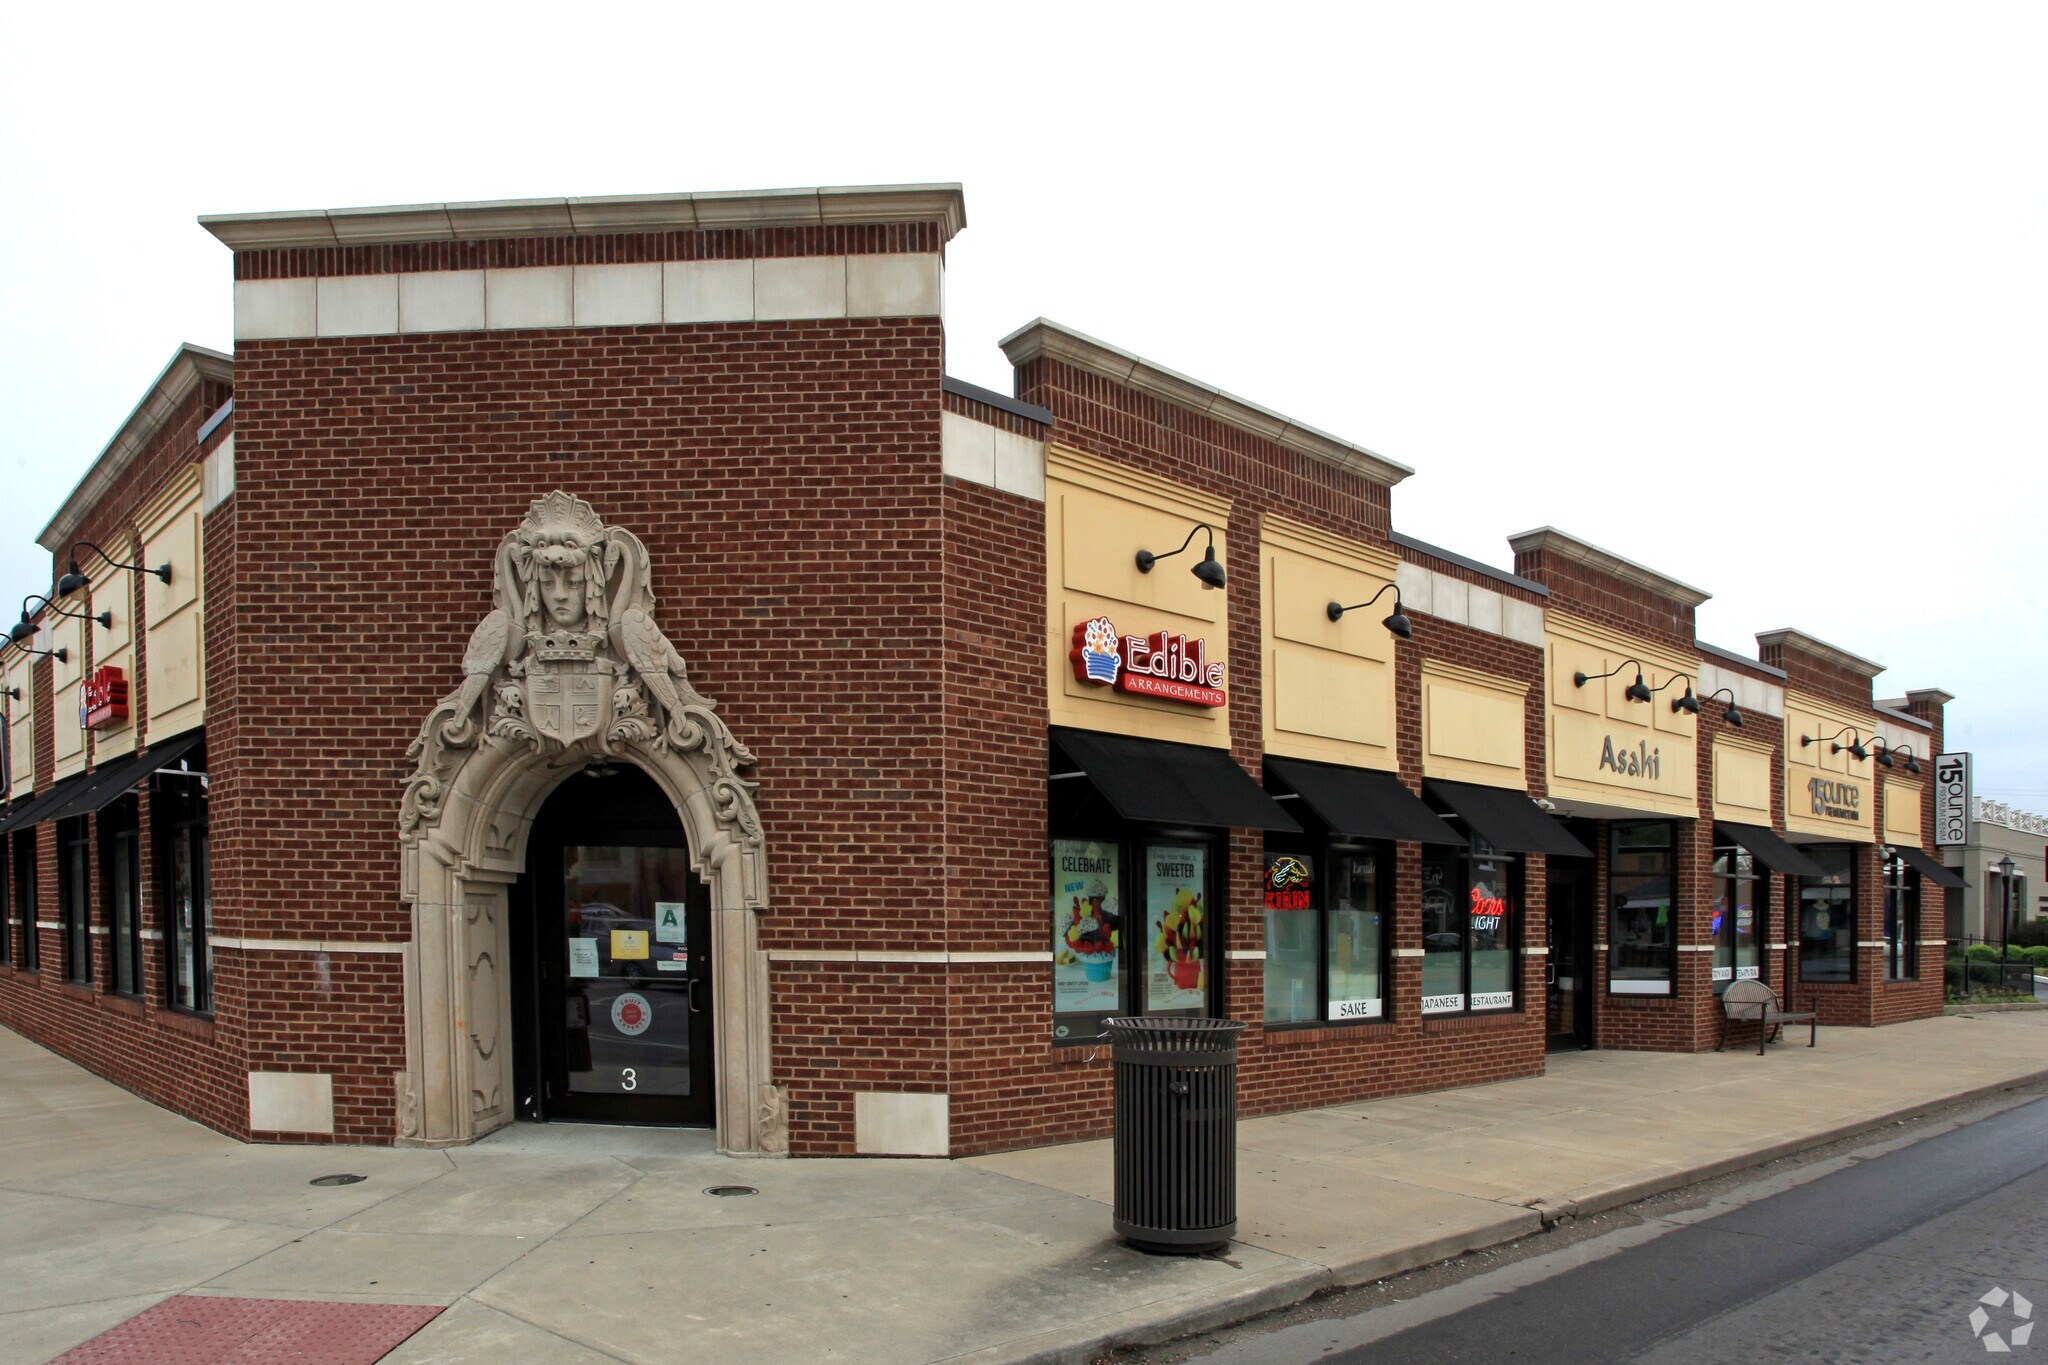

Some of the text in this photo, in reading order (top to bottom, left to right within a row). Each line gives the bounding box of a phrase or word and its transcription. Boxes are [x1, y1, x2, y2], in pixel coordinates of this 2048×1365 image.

[1125, 631, 1224, 687] Edible
[1128, 678, 1222, 703] ARRANGEMENTS
[1599, 735, 1660, 780] Asahi
[1939, 786, 1947, 817] PREMIUM
[1062, 856, 1112, 874] CELEBRATE
[1156, 862, 1195, 878] SWEETER
[1065, 880, 1084, 893] NEW
[1264, 890, 1310, 910] KIRIN
[662, 909, 679, 926] A
[620, 998, 642, 1007] FRUIT
[1340, 1002, 1367, 1017] SAKE
[618, 1017, 646, 1030] EXPERTS
[621, 1067, 637, 1091] 3
